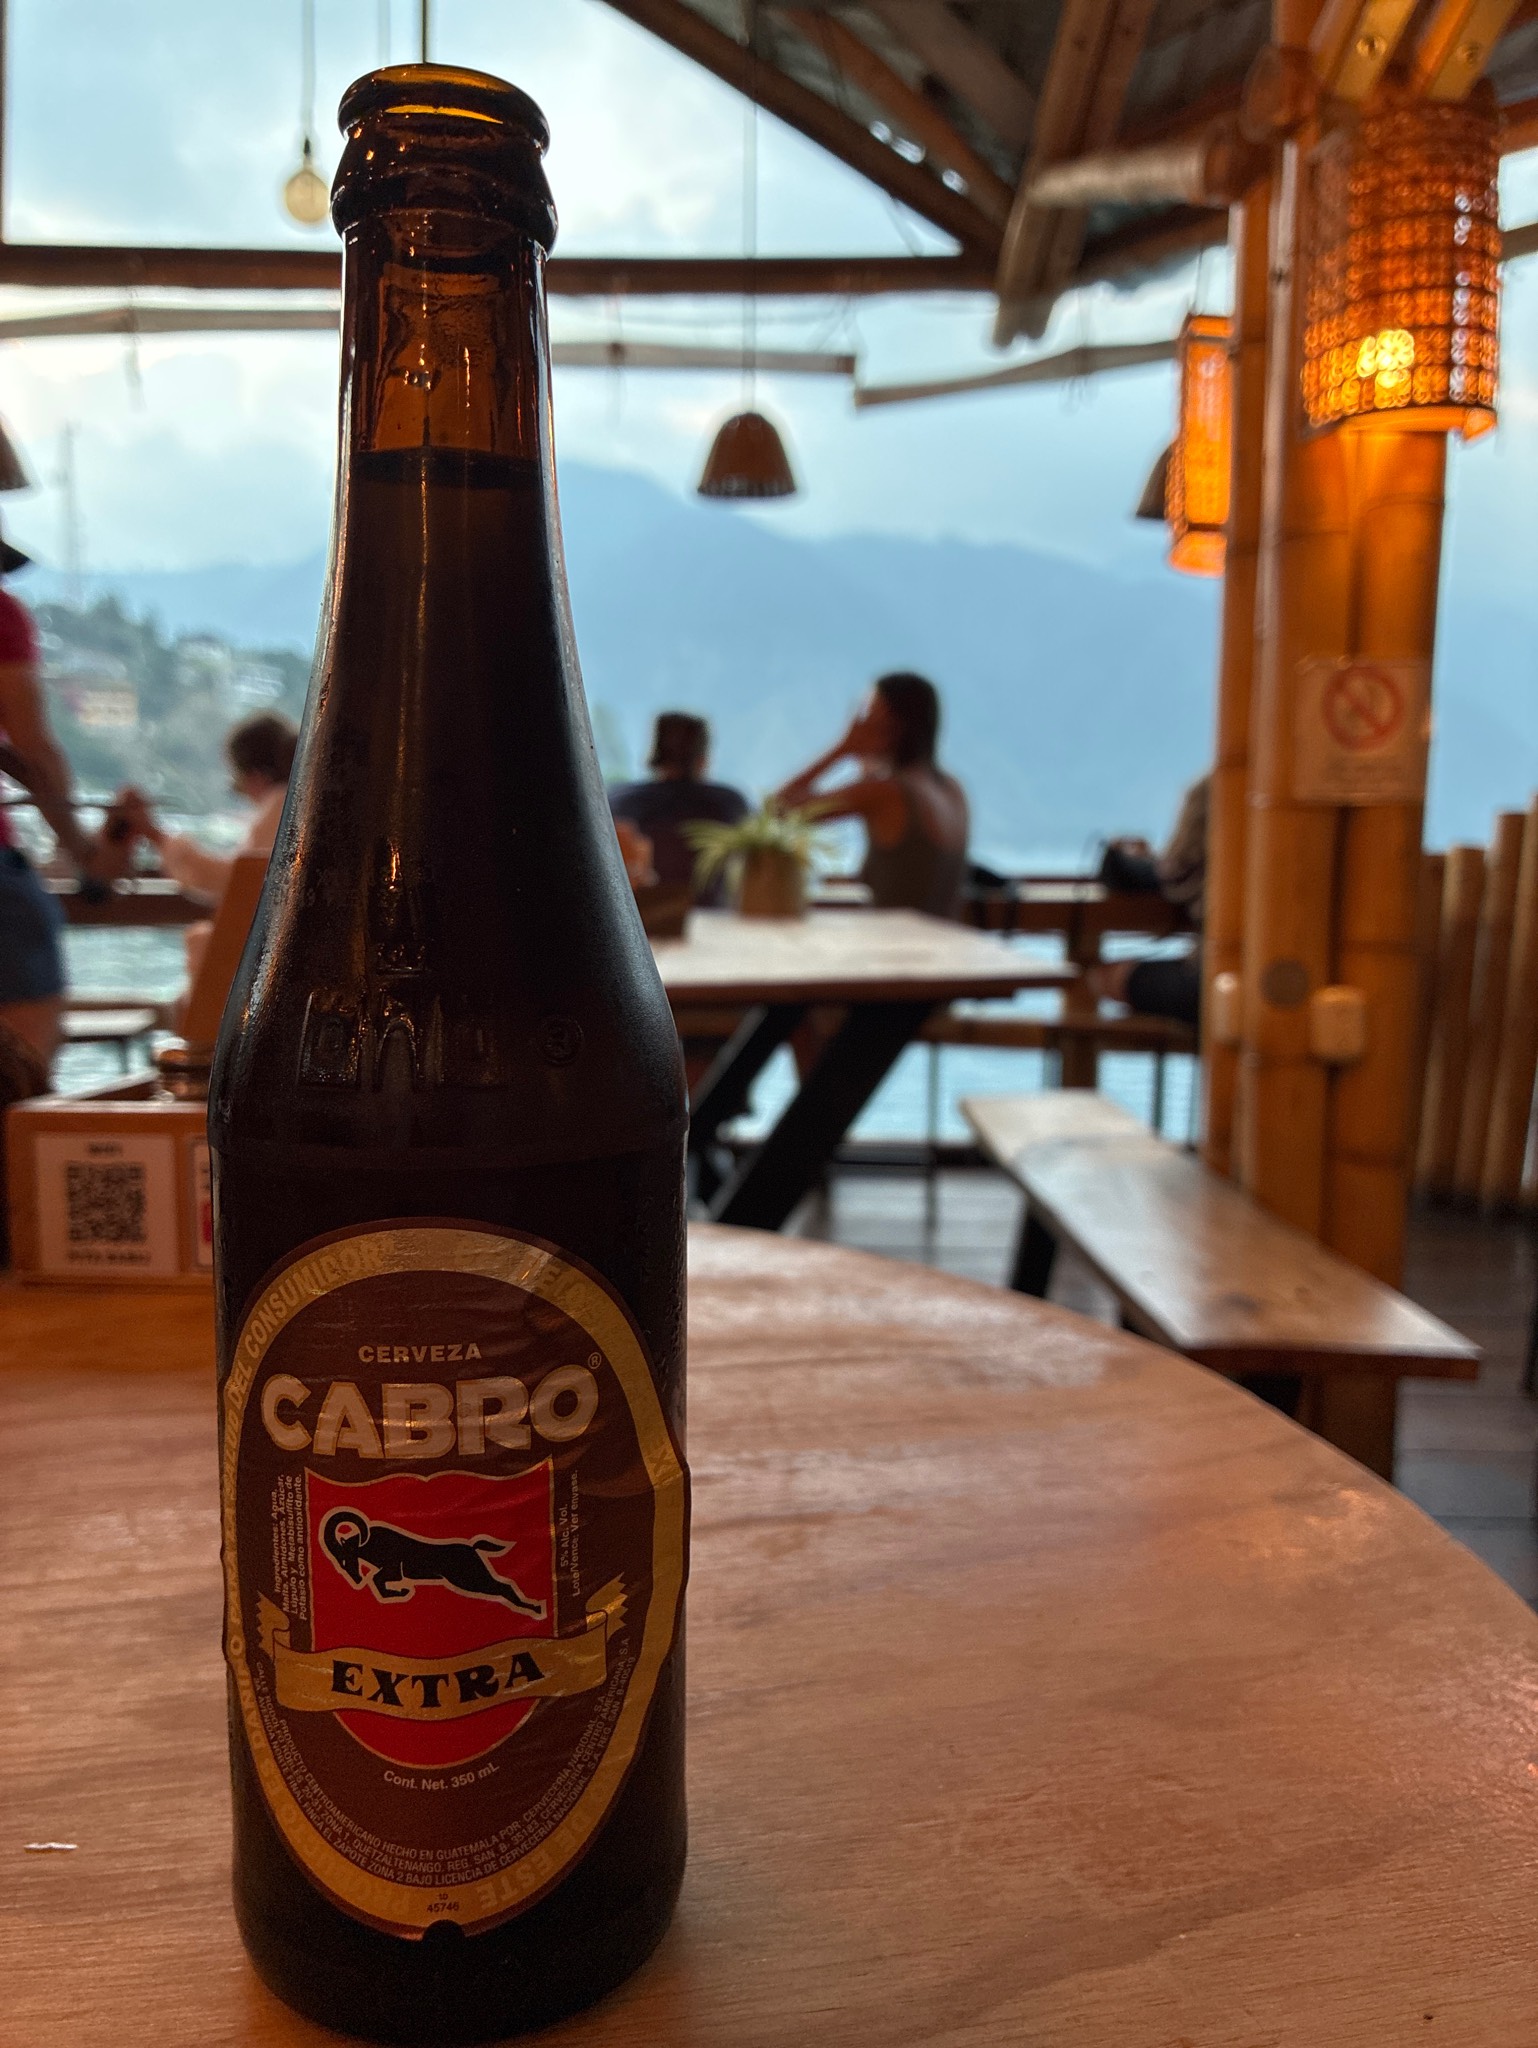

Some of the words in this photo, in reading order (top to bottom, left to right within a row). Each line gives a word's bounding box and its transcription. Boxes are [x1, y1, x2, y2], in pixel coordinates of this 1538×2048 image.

[358, 1343, 482, 1363] CERVEZA
[227, 1358, 255, 1411] DEL
[260, 1364, 600, 1460] CABRO
[284, 1475, 293, 1490] de
[570, 1469, 580, 1511] envase.
[286, 1491, 296, 1563] Metabisulfito
[293, 1473, 304, 1545] antioxidante.
[558, 1503, 569, 1526] Vol.
[570, 1511, 580, 1533] Ver
[271, 1522, 283, 1593] Ingredientes:
[297, 1546, 306, 1577] como
[560, 1527, 571, 1549] Alc.
[560, 1552, 569, 1568] 5%
[290, 1567, 299, 1575] y
[570, 1533, 581, 1598] Lote/Vence:
[299, 1579, 308, 1621] Potasio
[331, 1651, 546, 1708] EXTRA
[255, 1661, 269, 1694] CALLE
[263, 1694, 285, 1744] RODOLFO
[280, 1744, 305, 1785] ROBLES
[300, 1785, 324, 1813] 20-31
[319, 1810, 345, 1836] ZONA
[580, 1720, 606, 1764] CENTRO
[257, 1695, 277, 1741] AVENIDA
[270, 1740, 291, 1776] NORTE
[284, 1774, 306, 1803] FINAL
[300, 1801, 327, 1831] FINCA
[321, 1826, 336, 1841] EL
[332, 1837, 370, 1868] ZAPOTE
[366, 1859, 397, 1880] ZONA
[395, 1870, 405, 1882] 2
[405, 1872, 433, 1885] BAJO
[435, 1866, 484, 1885] LICENCIA
[482, 1859, 500, 1874] DE
[278, 1718, 309, 1774] PRODUCTO
[303, 1772, 383, 1849] CENTROAMERICANO
[380, 1840, 418, 1860] HECHO
[419, 1850, 434, 1861] EN
[436, 1833, 500, 1861] GUATEMALA
[498, 1817, 525, 1841] POR:
[521, 1766, 573, 1824] CERVECERÍA
[383, 1770, 418, 1790] Cont.
[421, 1778, 449, 1792] Net.
[450, 1771, 476, 1789] 350
[477, 1761, 501, 1781] mL
[474, 1847, 558, 1911] ESTE
